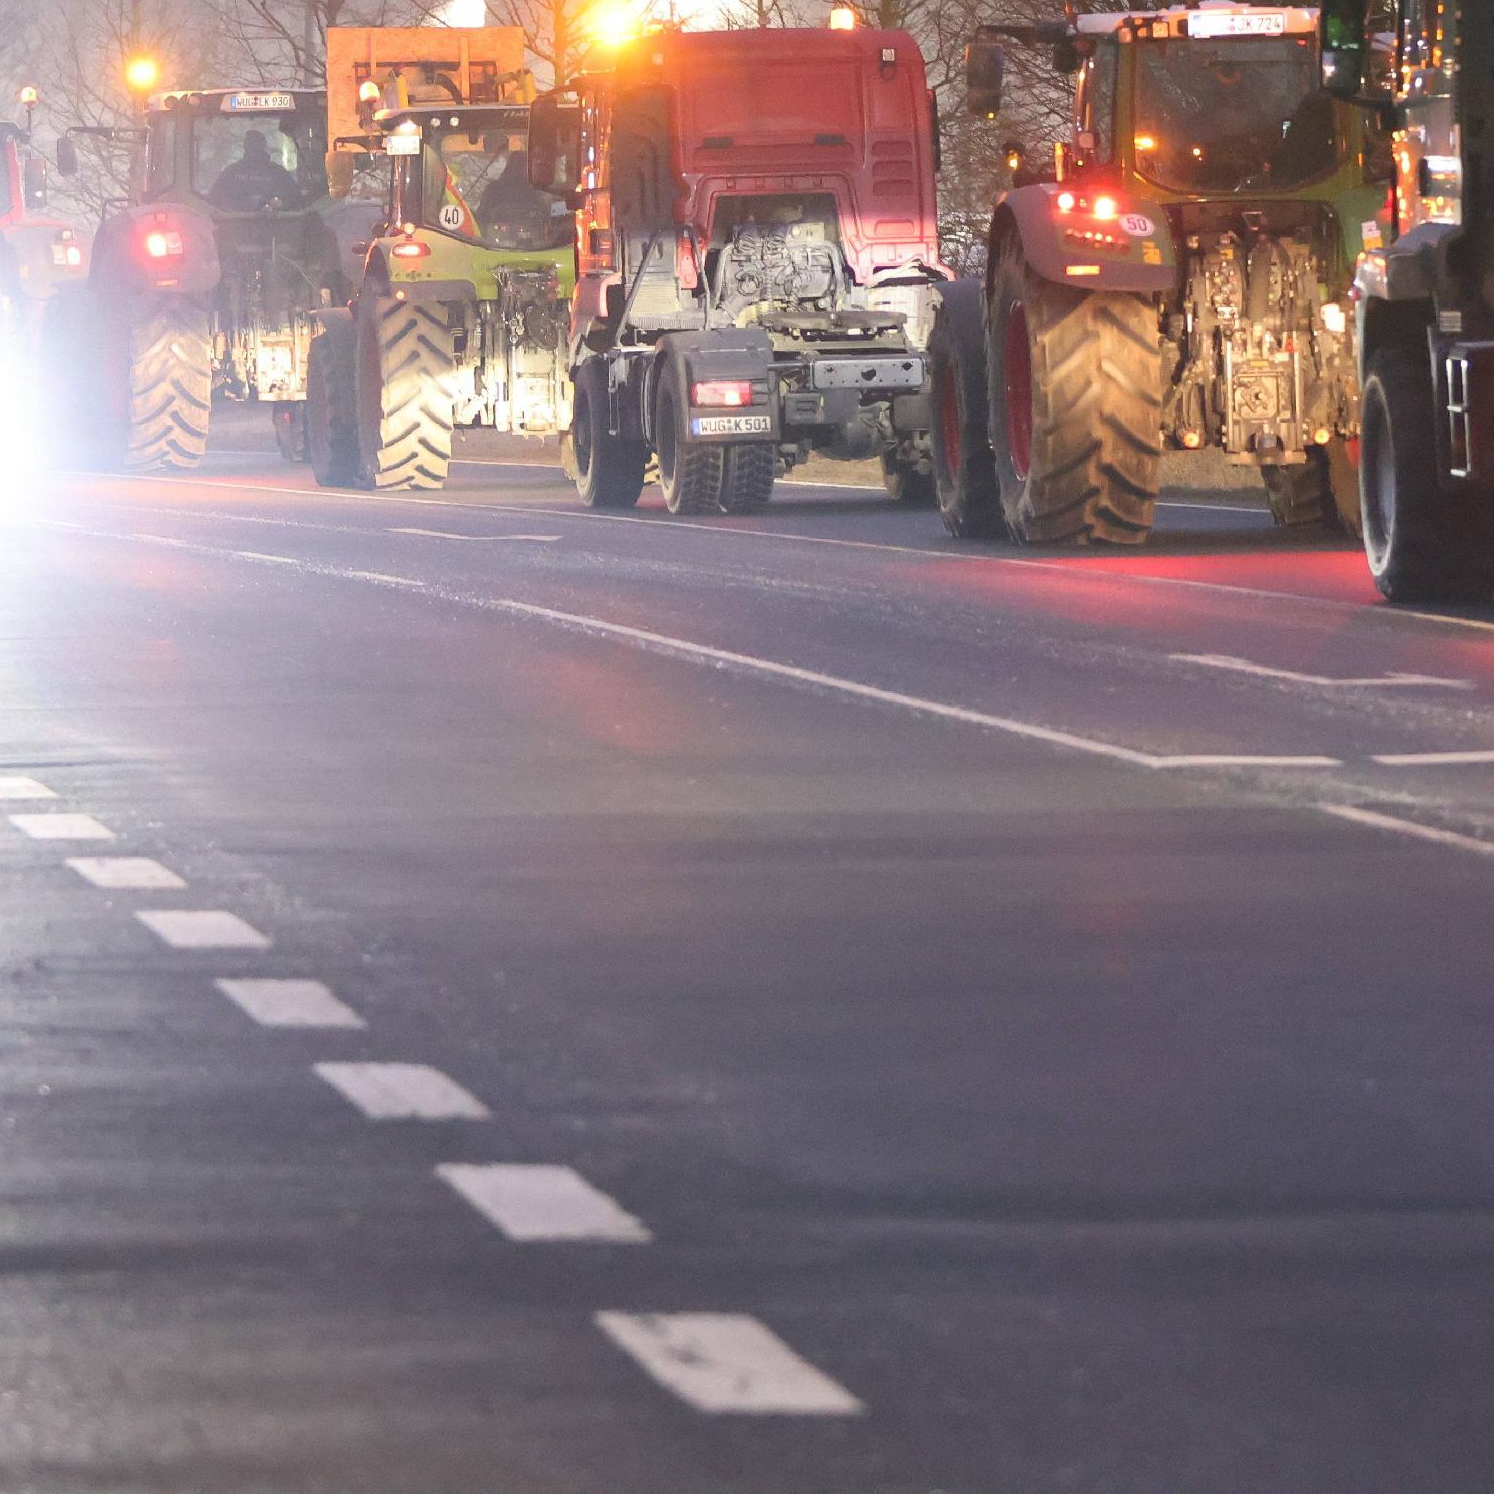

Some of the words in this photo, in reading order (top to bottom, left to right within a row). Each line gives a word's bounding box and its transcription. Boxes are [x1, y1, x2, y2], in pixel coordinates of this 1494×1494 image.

[272, 96, 289, 107] 930
[444, 208, 459, 224] 40
[1126, 217, 1147, 232] 50
[701, 419, 726, 432] WUG
[734, 418, 743, 431] K
[744, 417, 769, 431] 501
